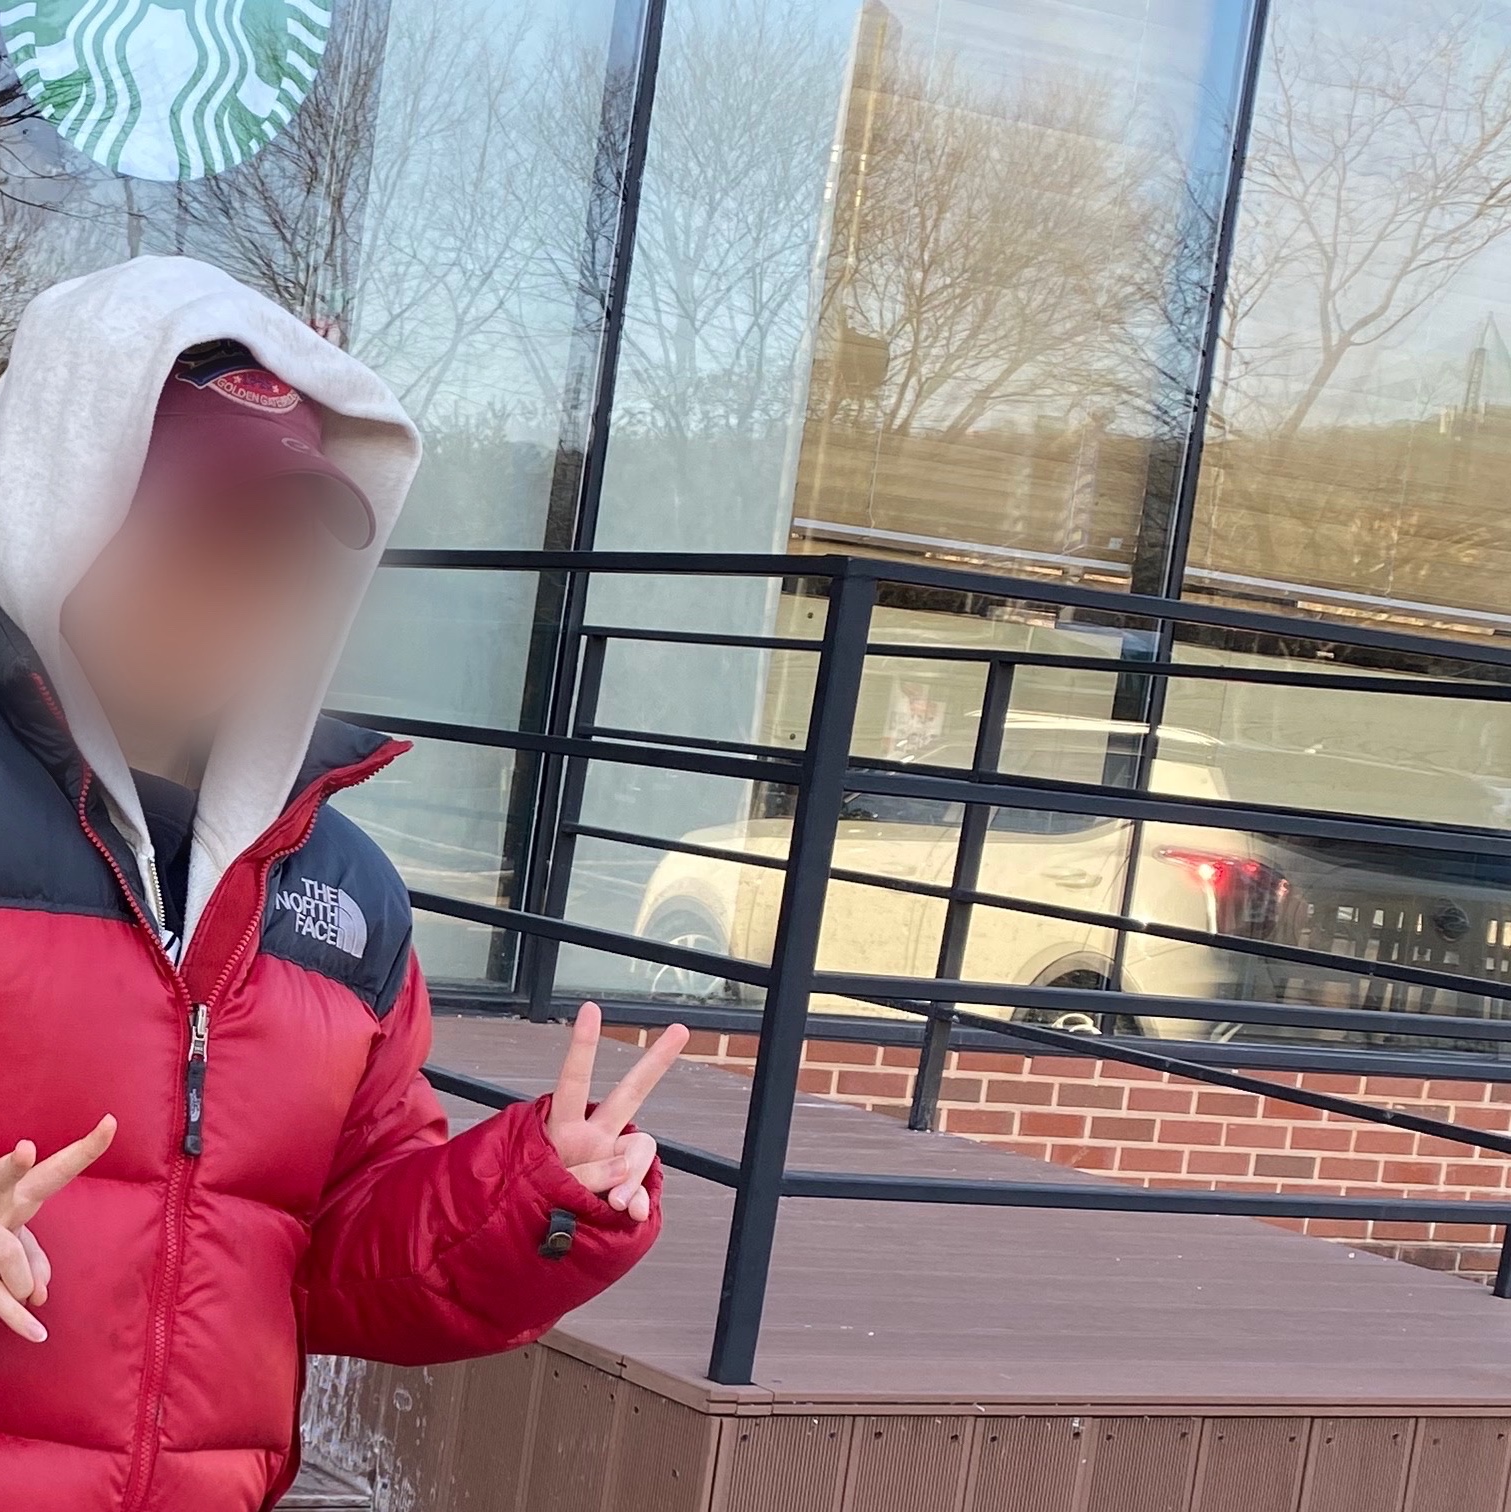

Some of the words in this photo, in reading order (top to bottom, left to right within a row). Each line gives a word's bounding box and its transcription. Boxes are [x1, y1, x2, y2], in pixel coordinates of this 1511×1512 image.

[217, 378, 260, 403] GOLDEN
[301, 877, 338, 906] THE
[275, 890, 338, 926] NORTH
[295, 911, 338, 946] FACE
